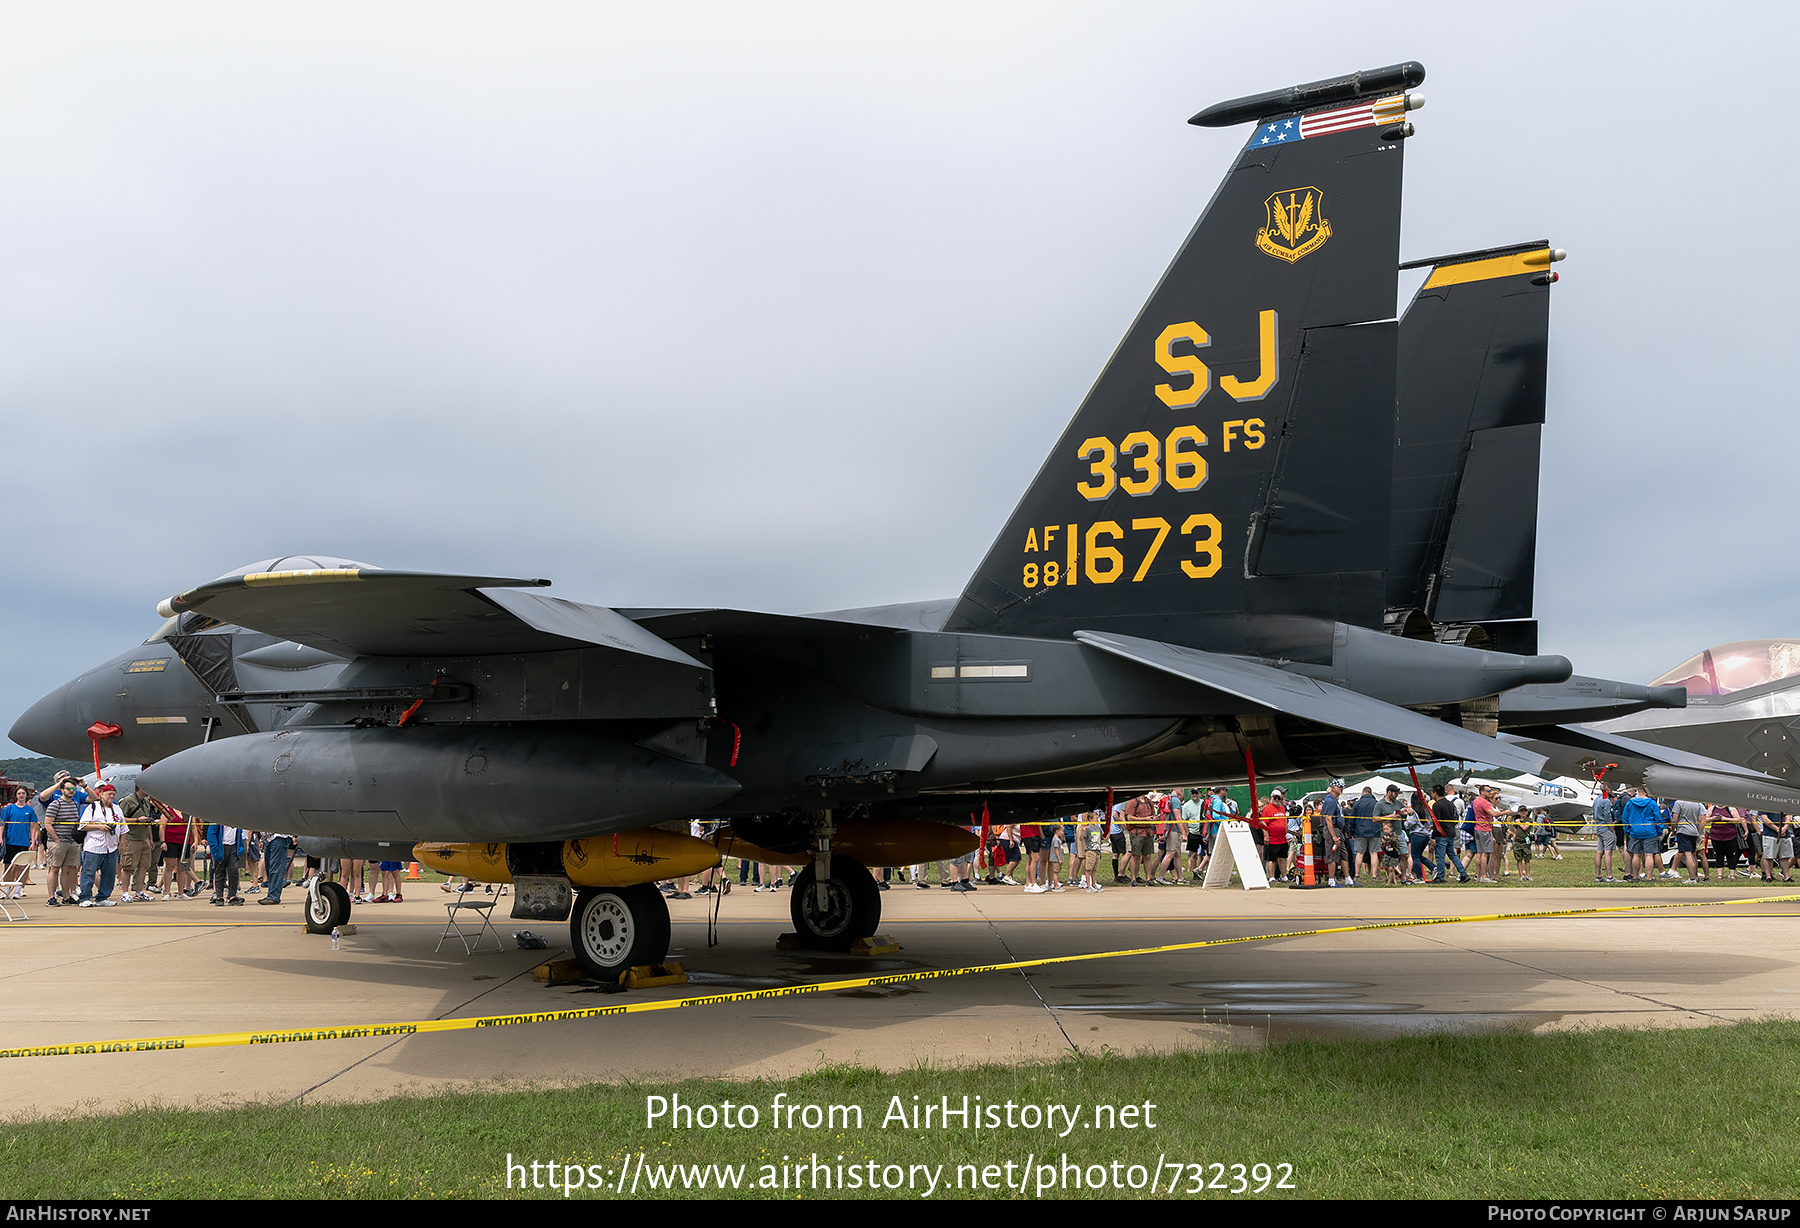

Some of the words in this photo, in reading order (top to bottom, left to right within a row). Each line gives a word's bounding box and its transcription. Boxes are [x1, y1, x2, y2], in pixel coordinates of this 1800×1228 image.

[1263, 243, 1273, 251] AIR
[1273, 248, 1297, 259] COMBAT
[1297, 235, 1325, 255] COMMAND
[1155, 309, 1279, 410] SJ
[1077, 424, 1209, 501] 336
[1223, 418, 1266, 453] FS
[1023, 525, 1060, 553] AF
[1067, 513, 1223, 585] 1673
[1022, 561, 1060, 589] 88
